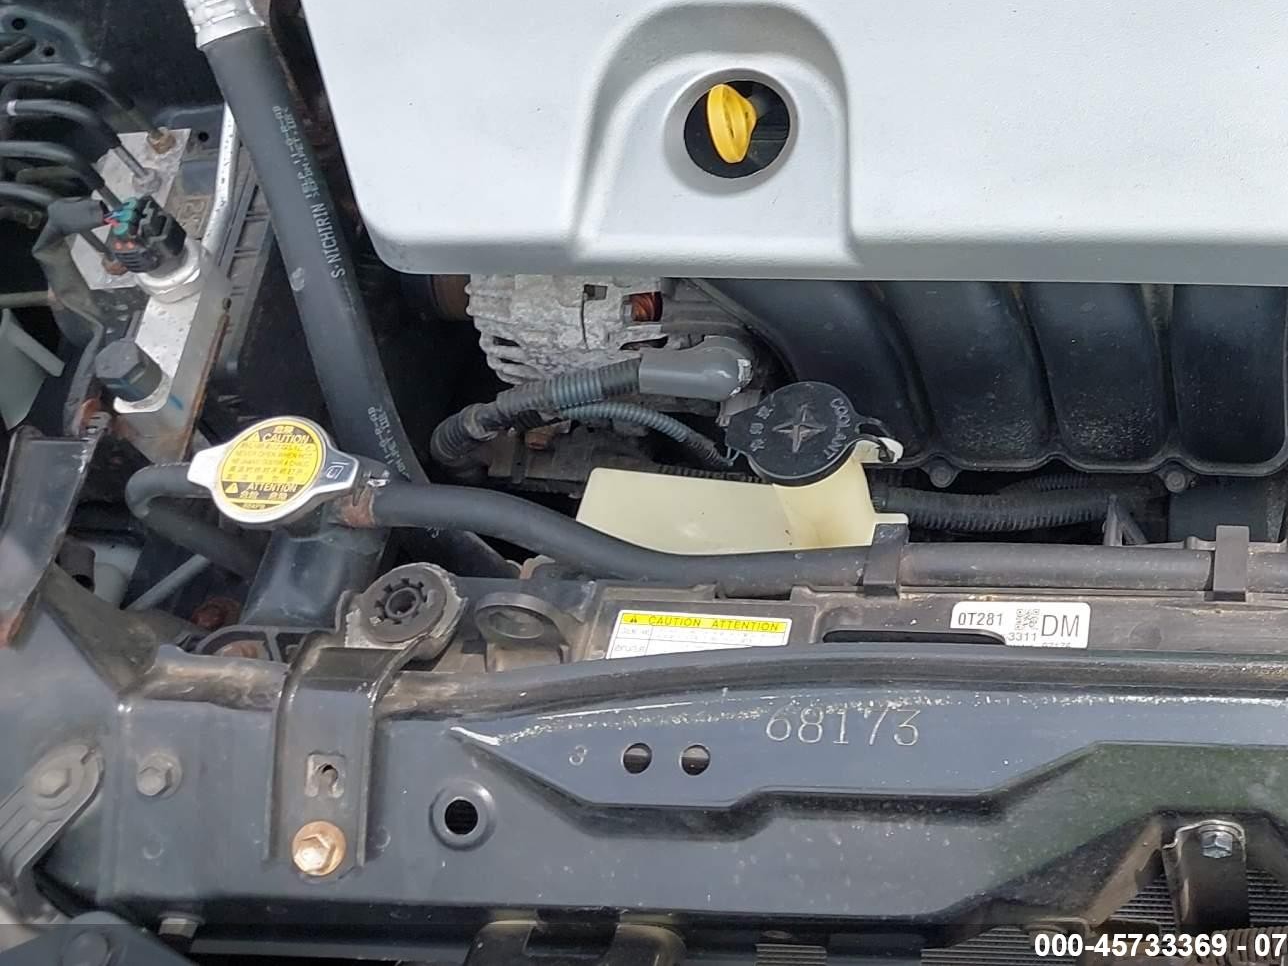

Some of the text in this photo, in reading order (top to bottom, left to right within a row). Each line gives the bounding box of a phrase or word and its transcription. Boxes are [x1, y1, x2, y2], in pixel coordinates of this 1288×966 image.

[823, 397, 851, 460] COOLANT
[261, 434, 310, 444] CAUTION
[246, 484, 298, 493] ATTENTION
[648, 616, 779, 632] CAUTION ATTENTION
[1040, 614, 1081, 638] DM
